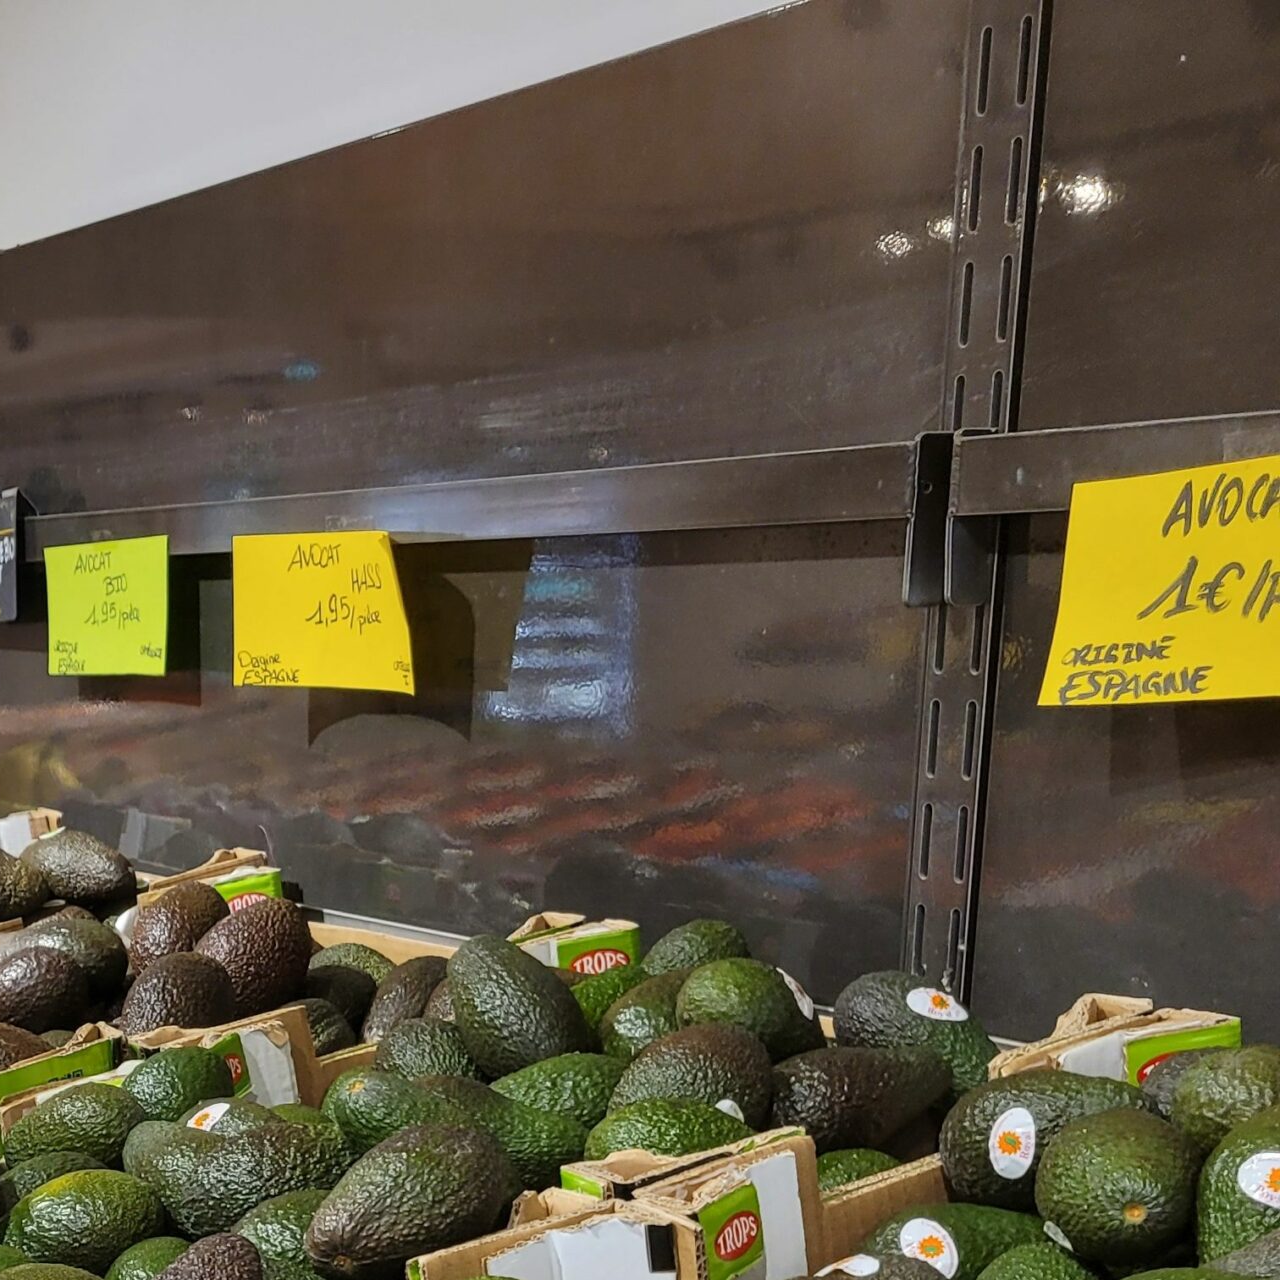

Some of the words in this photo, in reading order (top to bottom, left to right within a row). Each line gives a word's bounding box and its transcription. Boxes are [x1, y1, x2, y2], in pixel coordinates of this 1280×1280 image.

[74, 551, 112, 576] AVOCAT
[287, 542, 342, 573] AVOCAT
[102, 573, 129, 597] BIO
[350, 563, 382, 595] HASS
[1061, 636, 1177, 667] ORIGINE
[241, 667, 300, 687] ESPAGNE
[1058, 666, 1213, 705] ESPAGNE
[1019, 1131, 1032, 1160] Royal
[717, 1215, 757, 1255] TROPS
